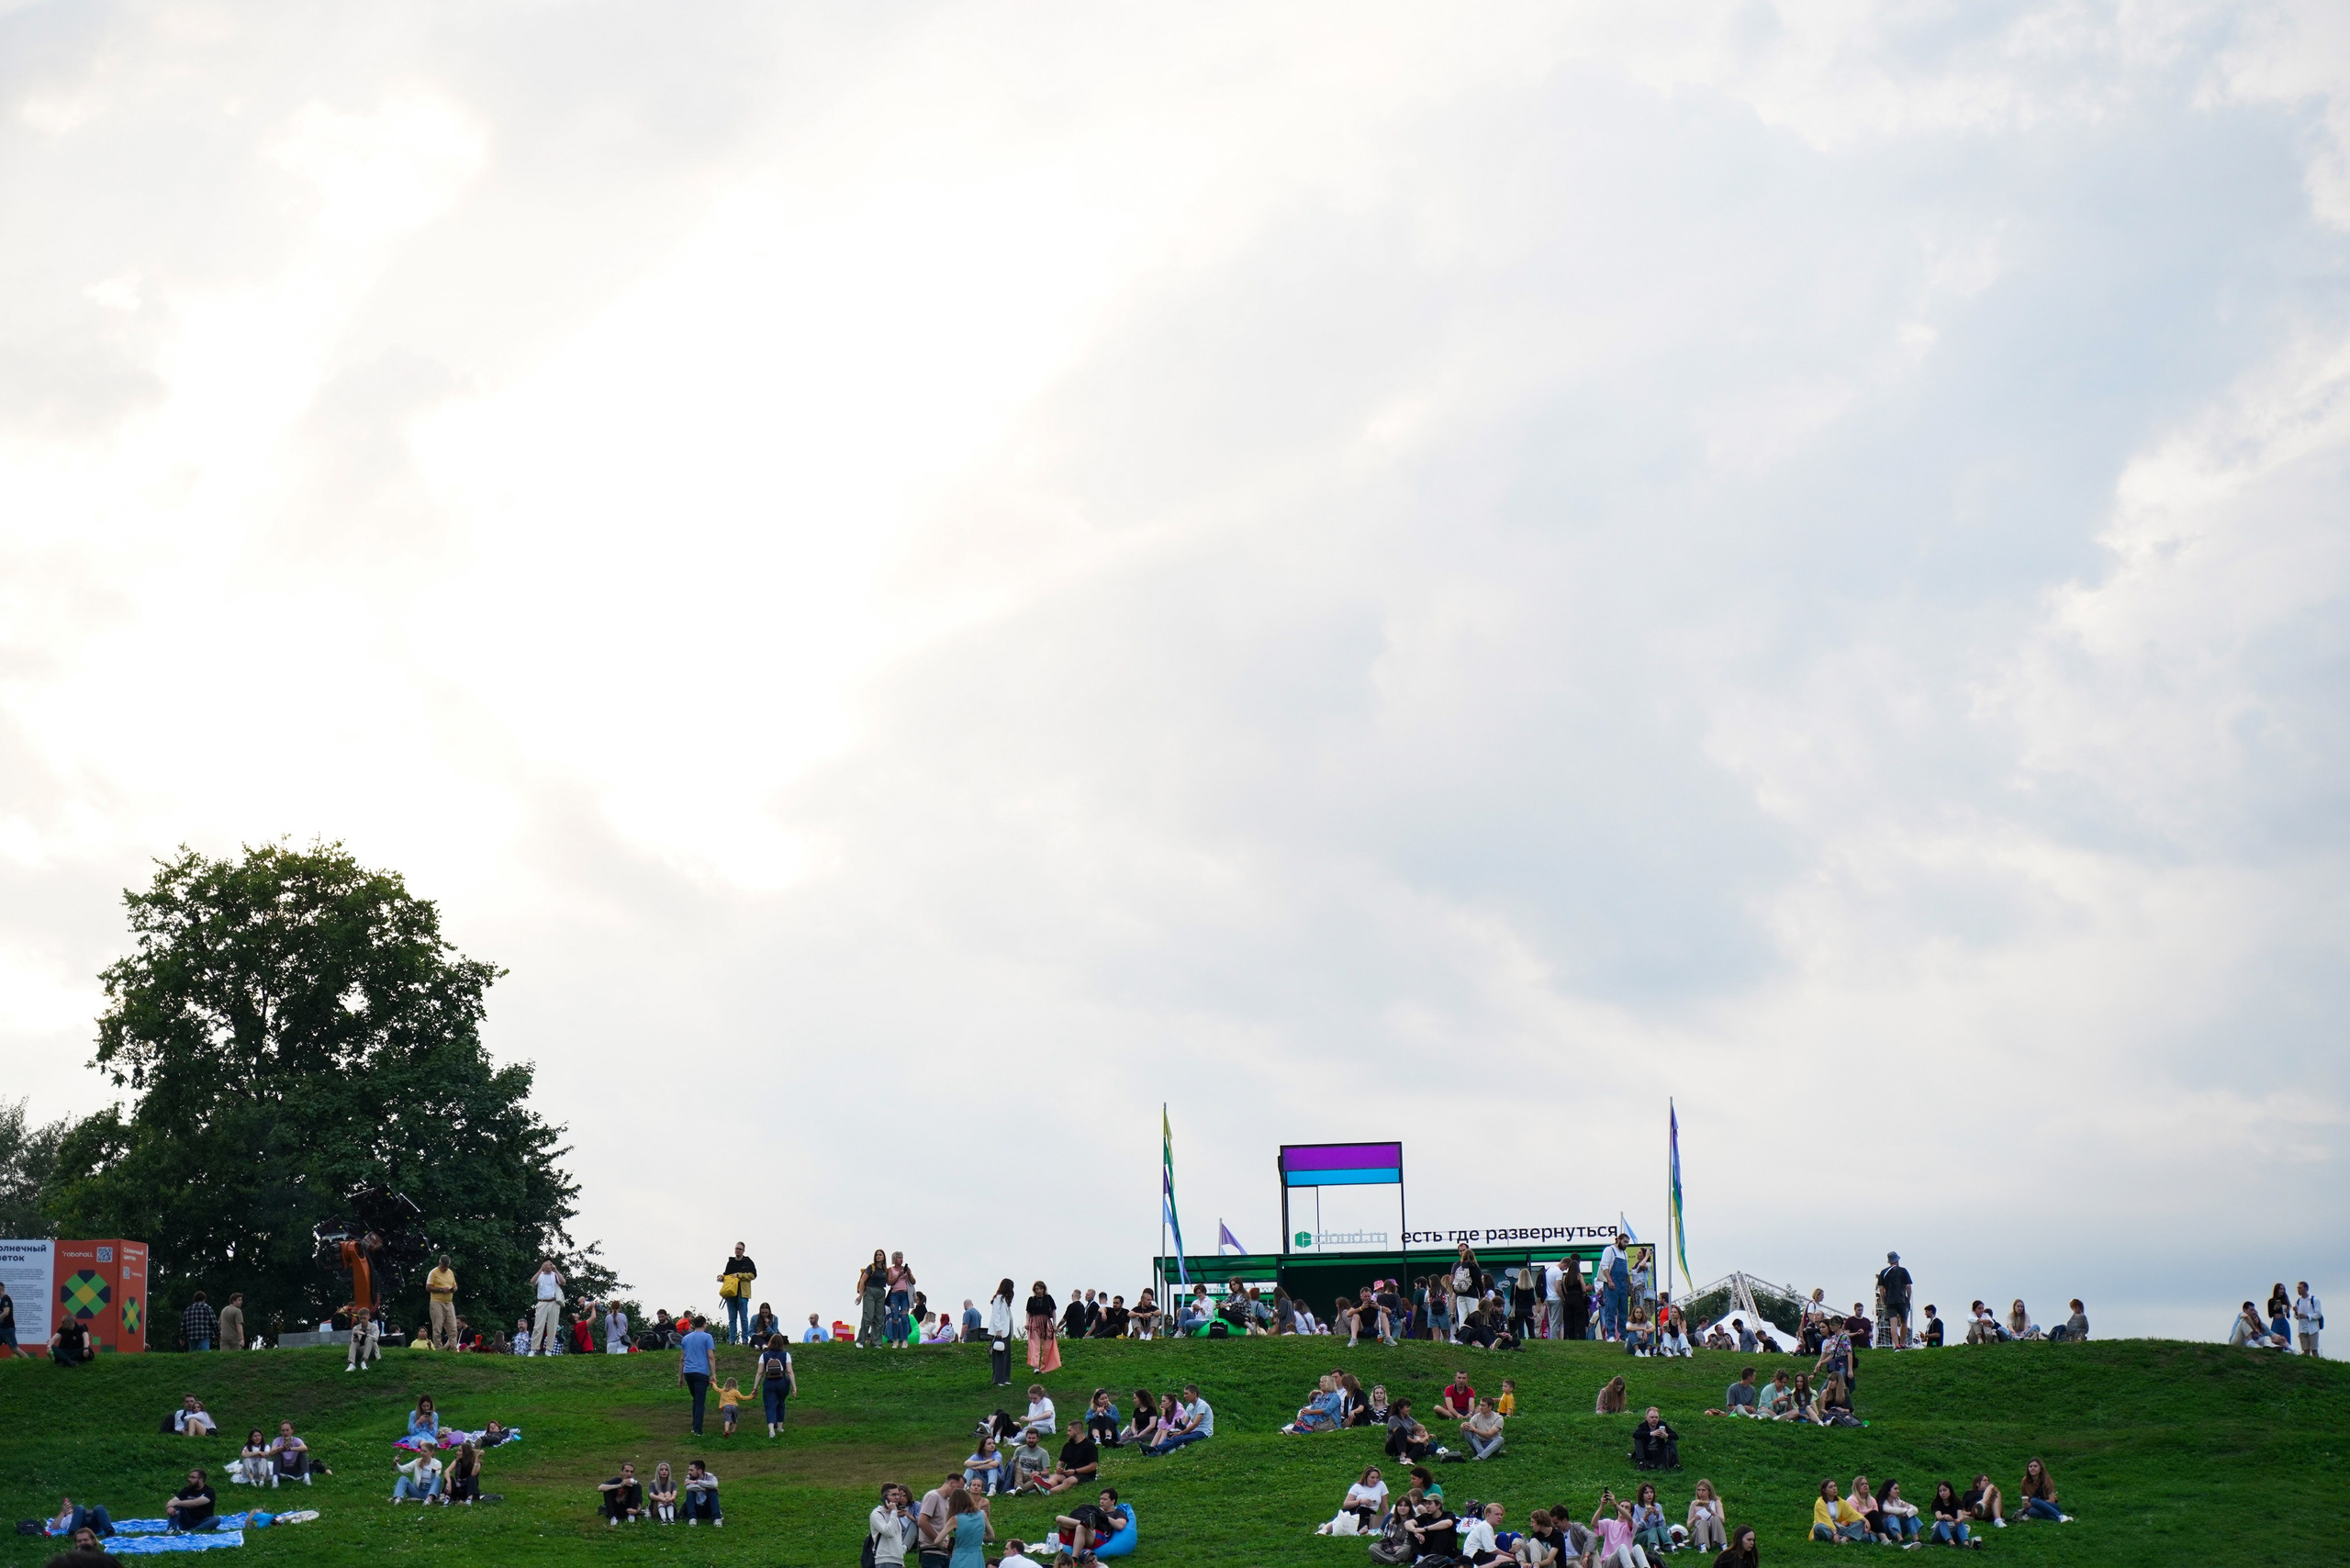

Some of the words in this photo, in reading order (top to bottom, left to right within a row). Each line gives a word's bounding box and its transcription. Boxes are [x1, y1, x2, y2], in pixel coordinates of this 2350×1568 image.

[1315, 1229, 1388, 1244] cloud.ru
[1402, 1231, 1443, 1243] есть
[1449, 1229, 1480, 1244] где
[1486, 1226, 1617, 1244] развернуться
